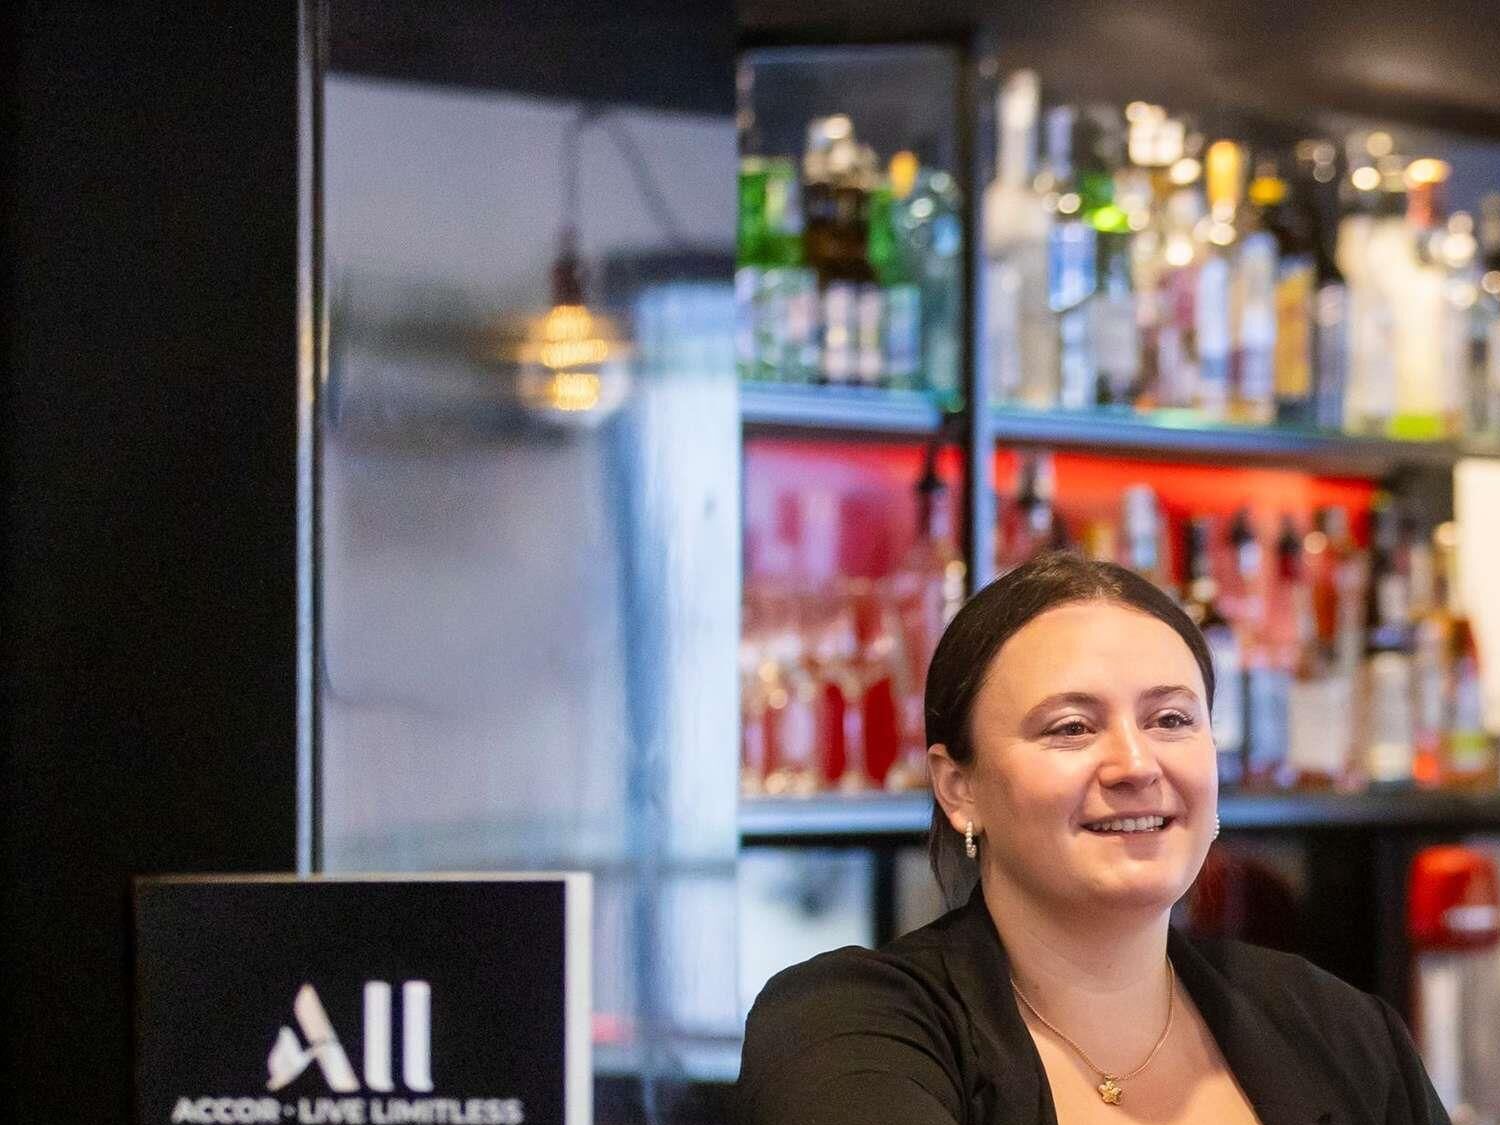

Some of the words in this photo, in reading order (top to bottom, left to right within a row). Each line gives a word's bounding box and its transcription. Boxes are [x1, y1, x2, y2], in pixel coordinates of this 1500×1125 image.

[170, 1097, 281, 1125] ACCOR
[298, 1098, 365, 1125] LIVE
[369, 1098, 525, 1125] LIMITLESS
